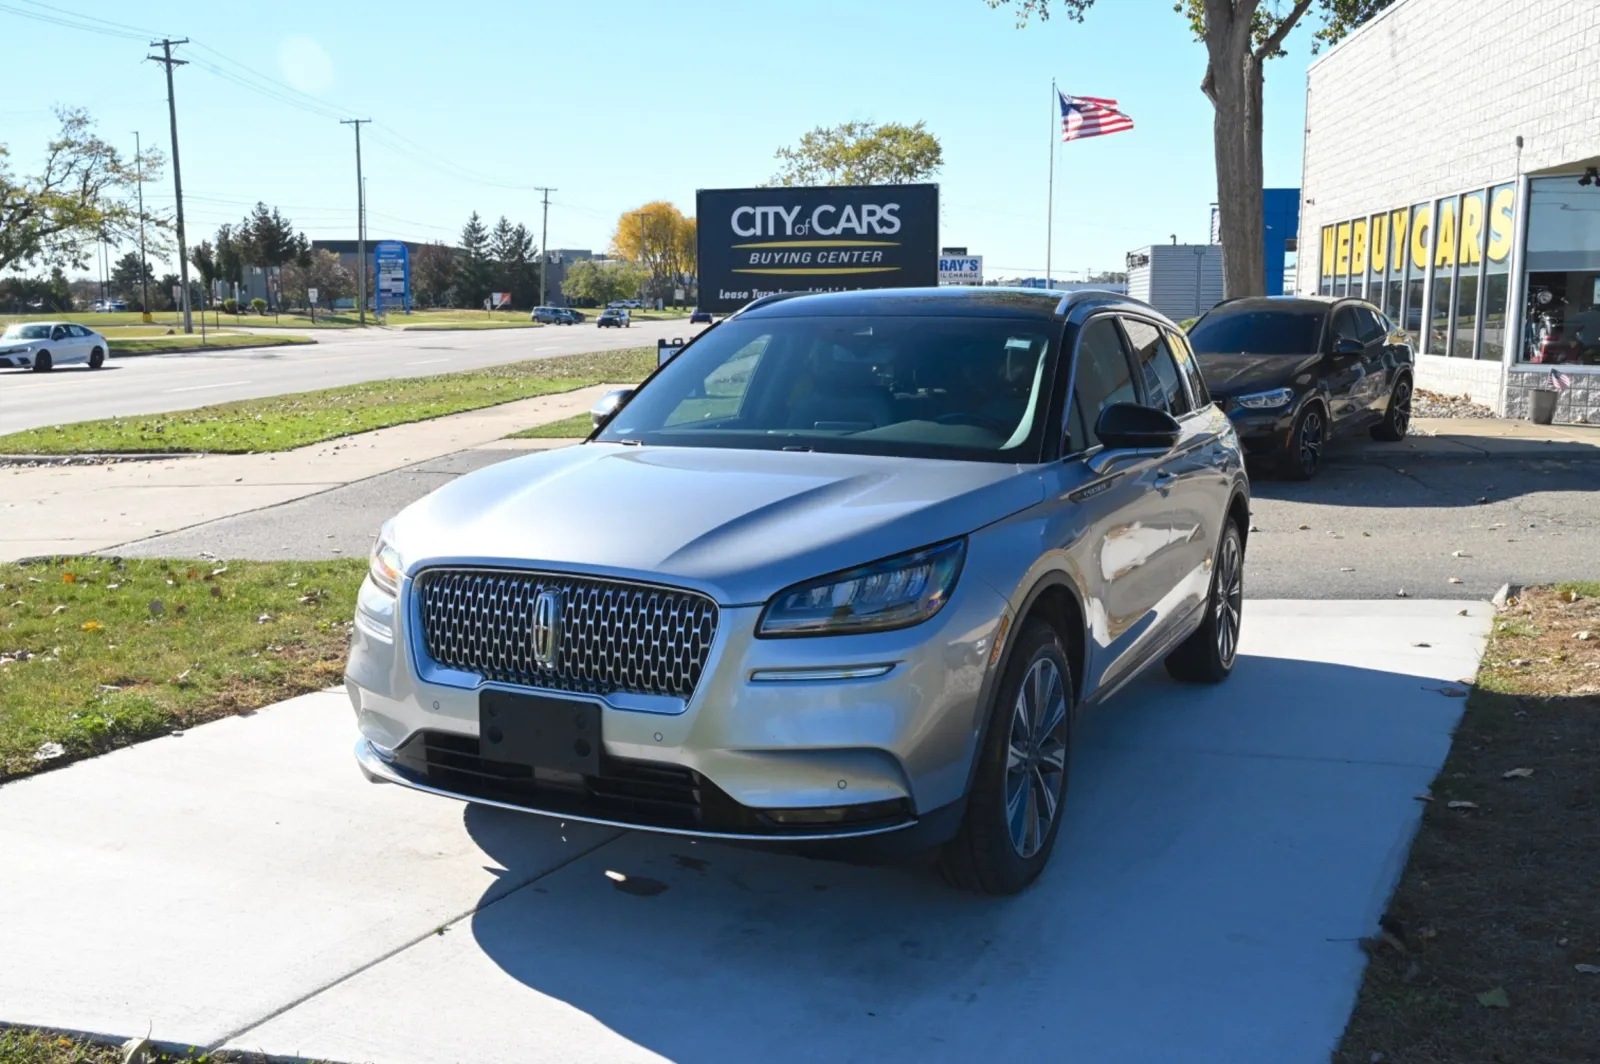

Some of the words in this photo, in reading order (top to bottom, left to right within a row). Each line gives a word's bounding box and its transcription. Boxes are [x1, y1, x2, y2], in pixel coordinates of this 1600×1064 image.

[731, 205, 801, 237] CITY
[794, 218, 811, 236] of
[811, 203, 901, 236] CARS
[749, 252, 812, 264] BUYING
[817, 250, 883, 263] CENTER
[719, 289, 749, 299] Lease
